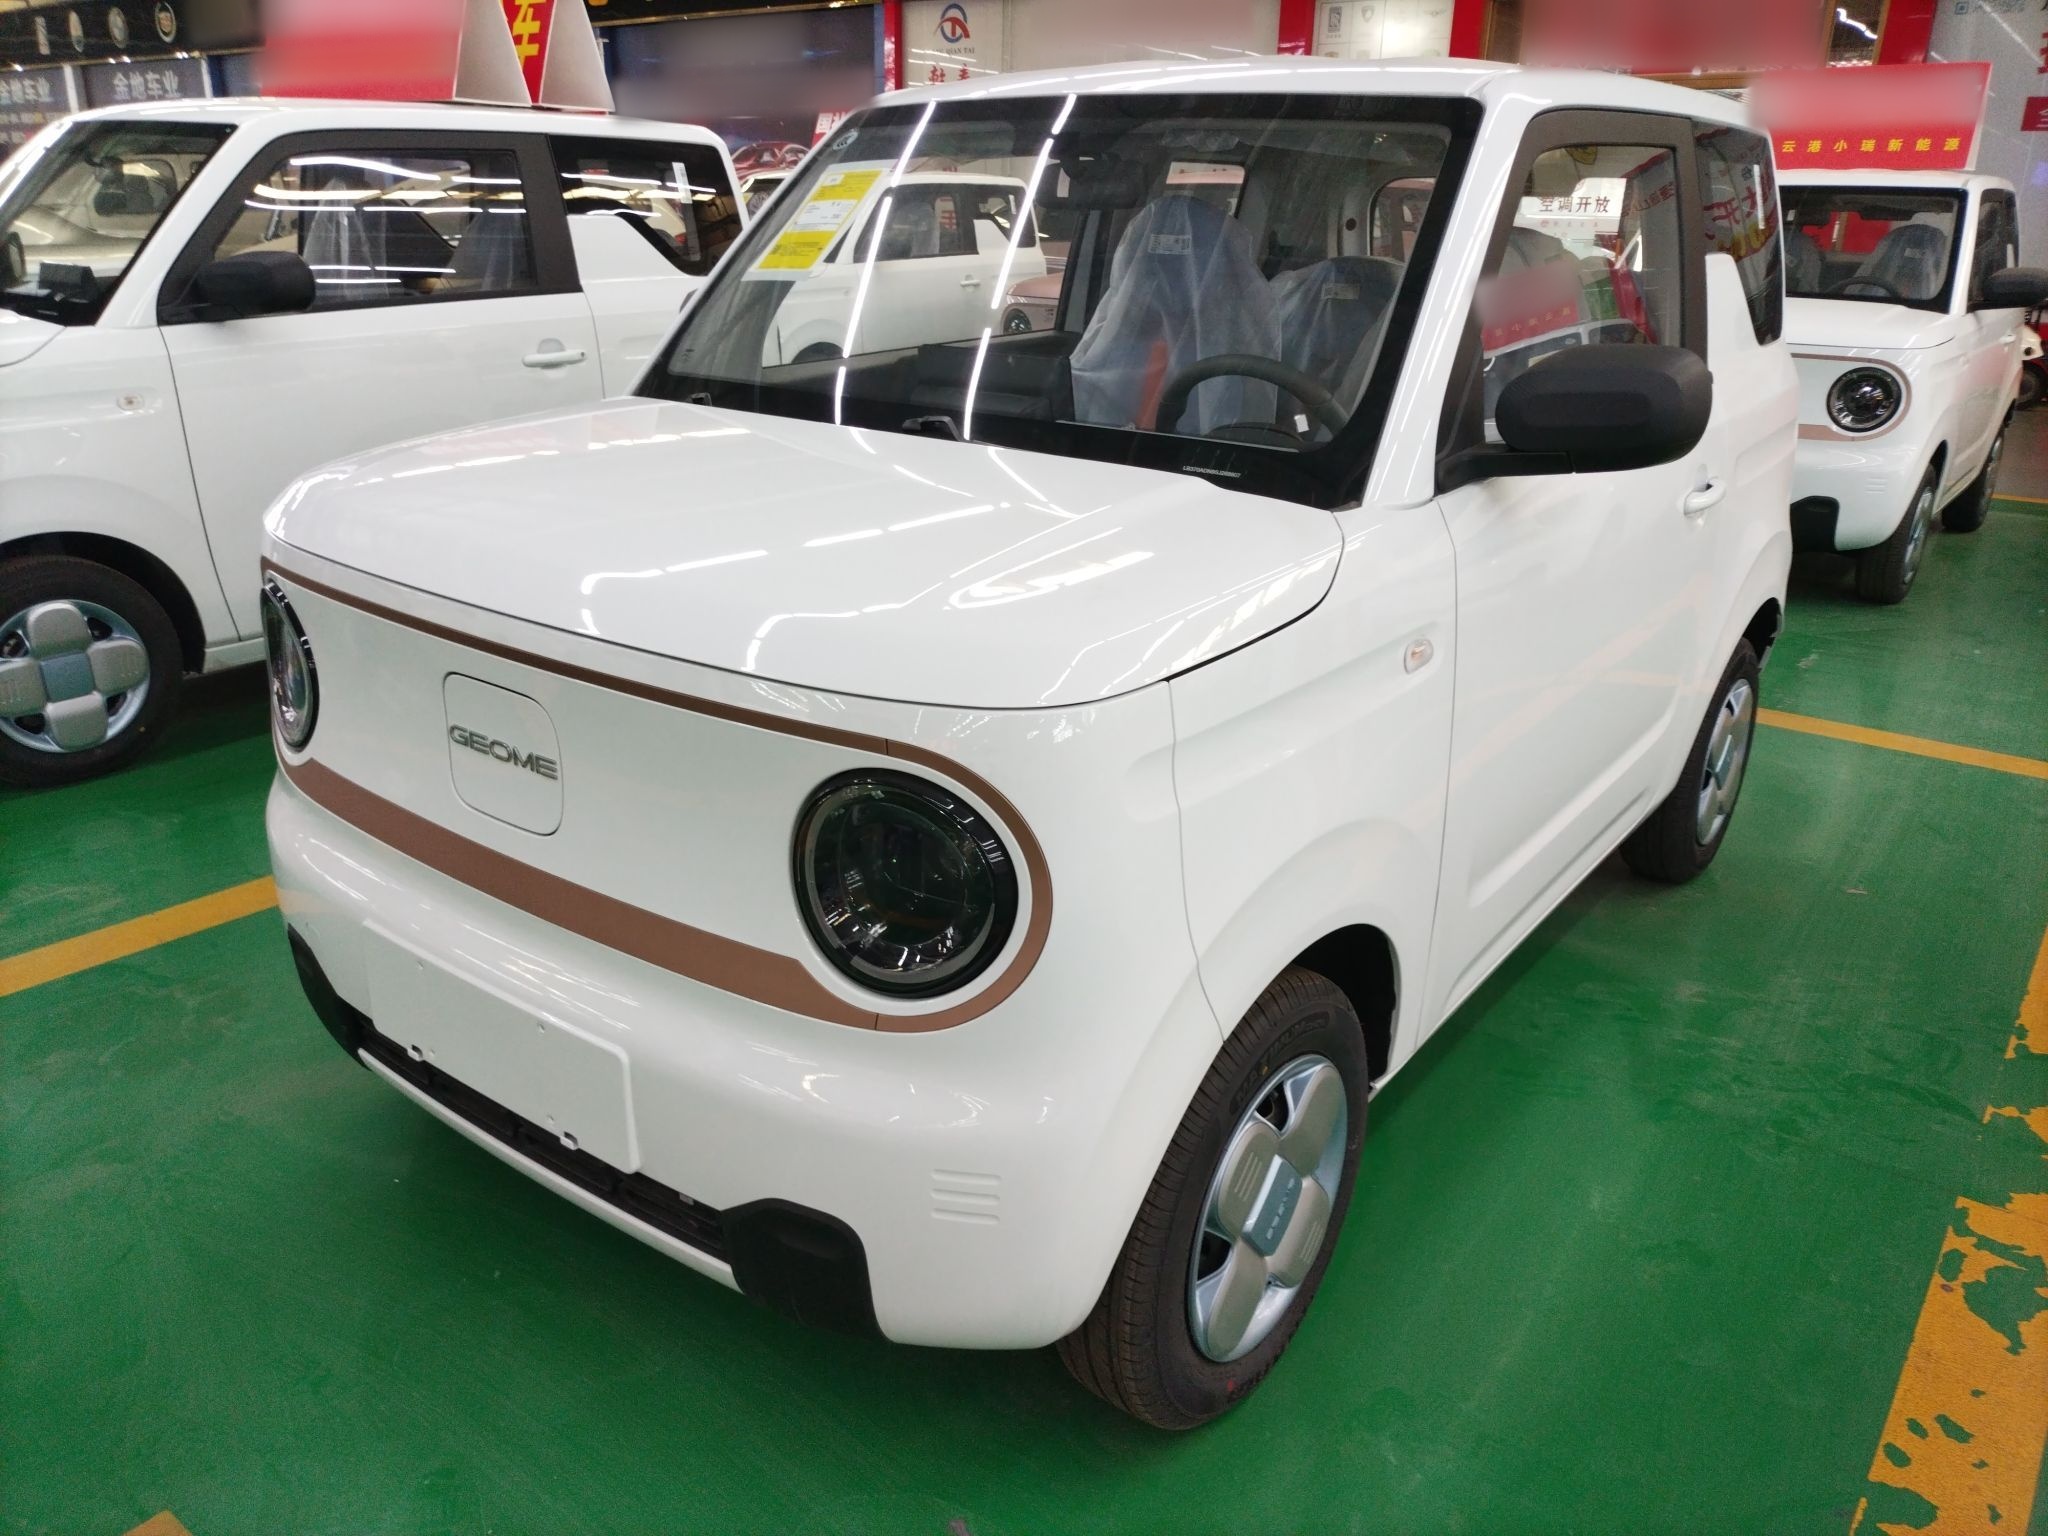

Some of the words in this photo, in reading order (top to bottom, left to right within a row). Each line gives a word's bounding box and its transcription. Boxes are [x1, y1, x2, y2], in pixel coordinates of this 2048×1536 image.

[1539, 195, 1610, 214] 空调开放
[449, 724, 558, 780] GEOME
